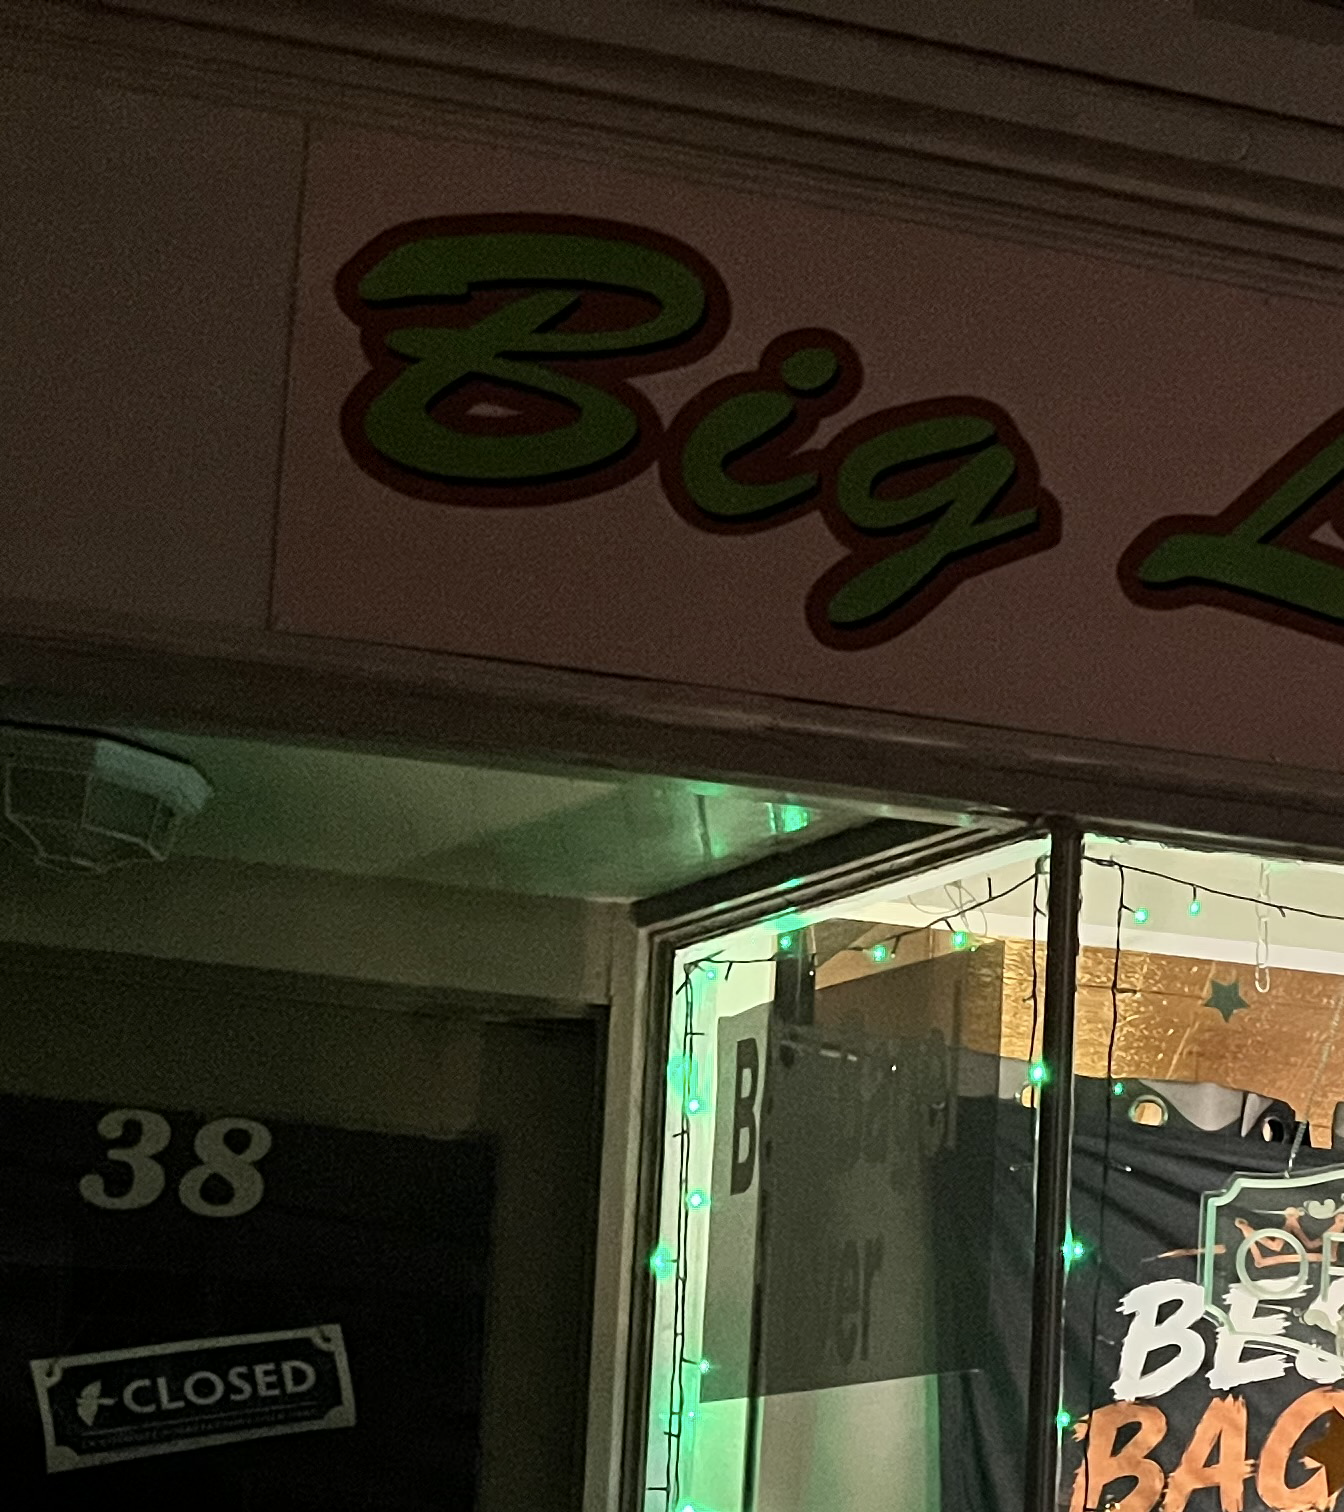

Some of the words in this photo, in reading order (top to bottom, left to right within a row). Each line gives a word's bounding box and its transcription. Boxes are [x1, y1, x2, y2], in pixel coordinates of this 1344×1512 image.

[335, 210, 1062, 650] Big
[78, 1108, 272, 1218] 38
[123, 1361, 317, 1415] CLOSED
